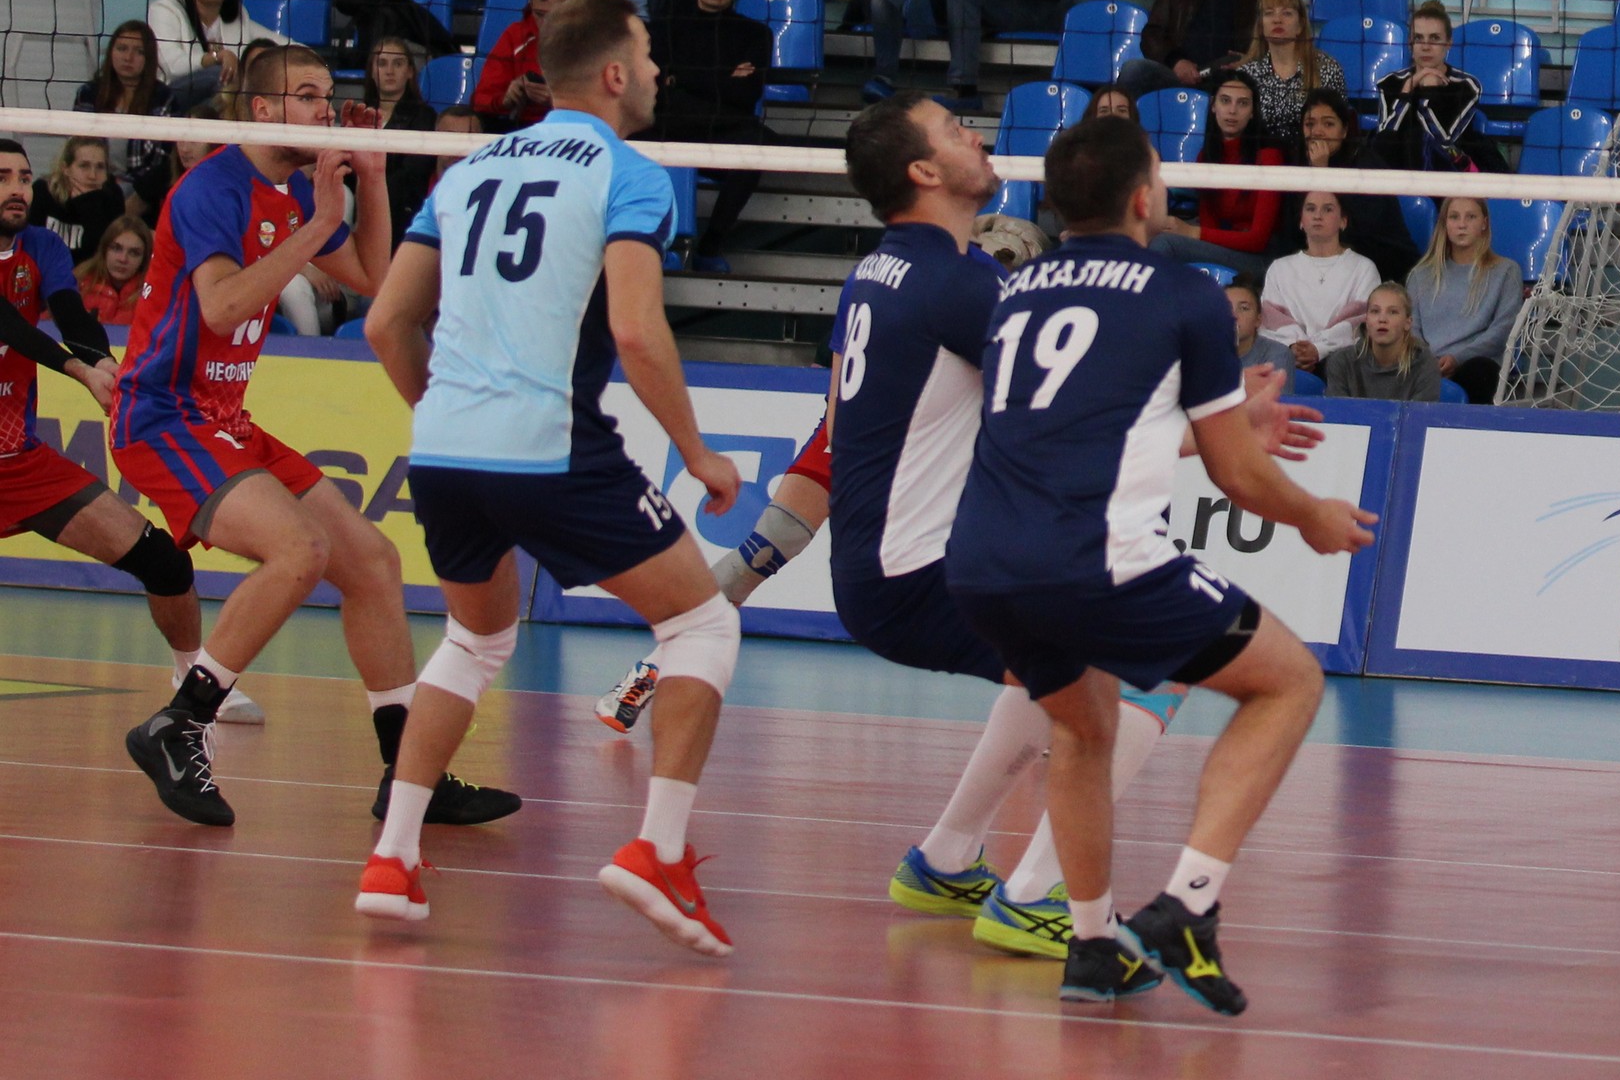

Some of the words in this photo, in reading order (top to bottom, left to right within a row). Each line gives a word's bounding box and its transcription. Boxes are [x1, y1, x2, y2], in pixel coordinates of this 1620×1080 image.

[469, 136, 604, 168] САХАЛИН
[460, 178, 560, 283] 15
[999, 259, 1156, 303] САХАЛИН
[991, 306, 1099, 413] 19
[637, 482, 674, 532] 15
